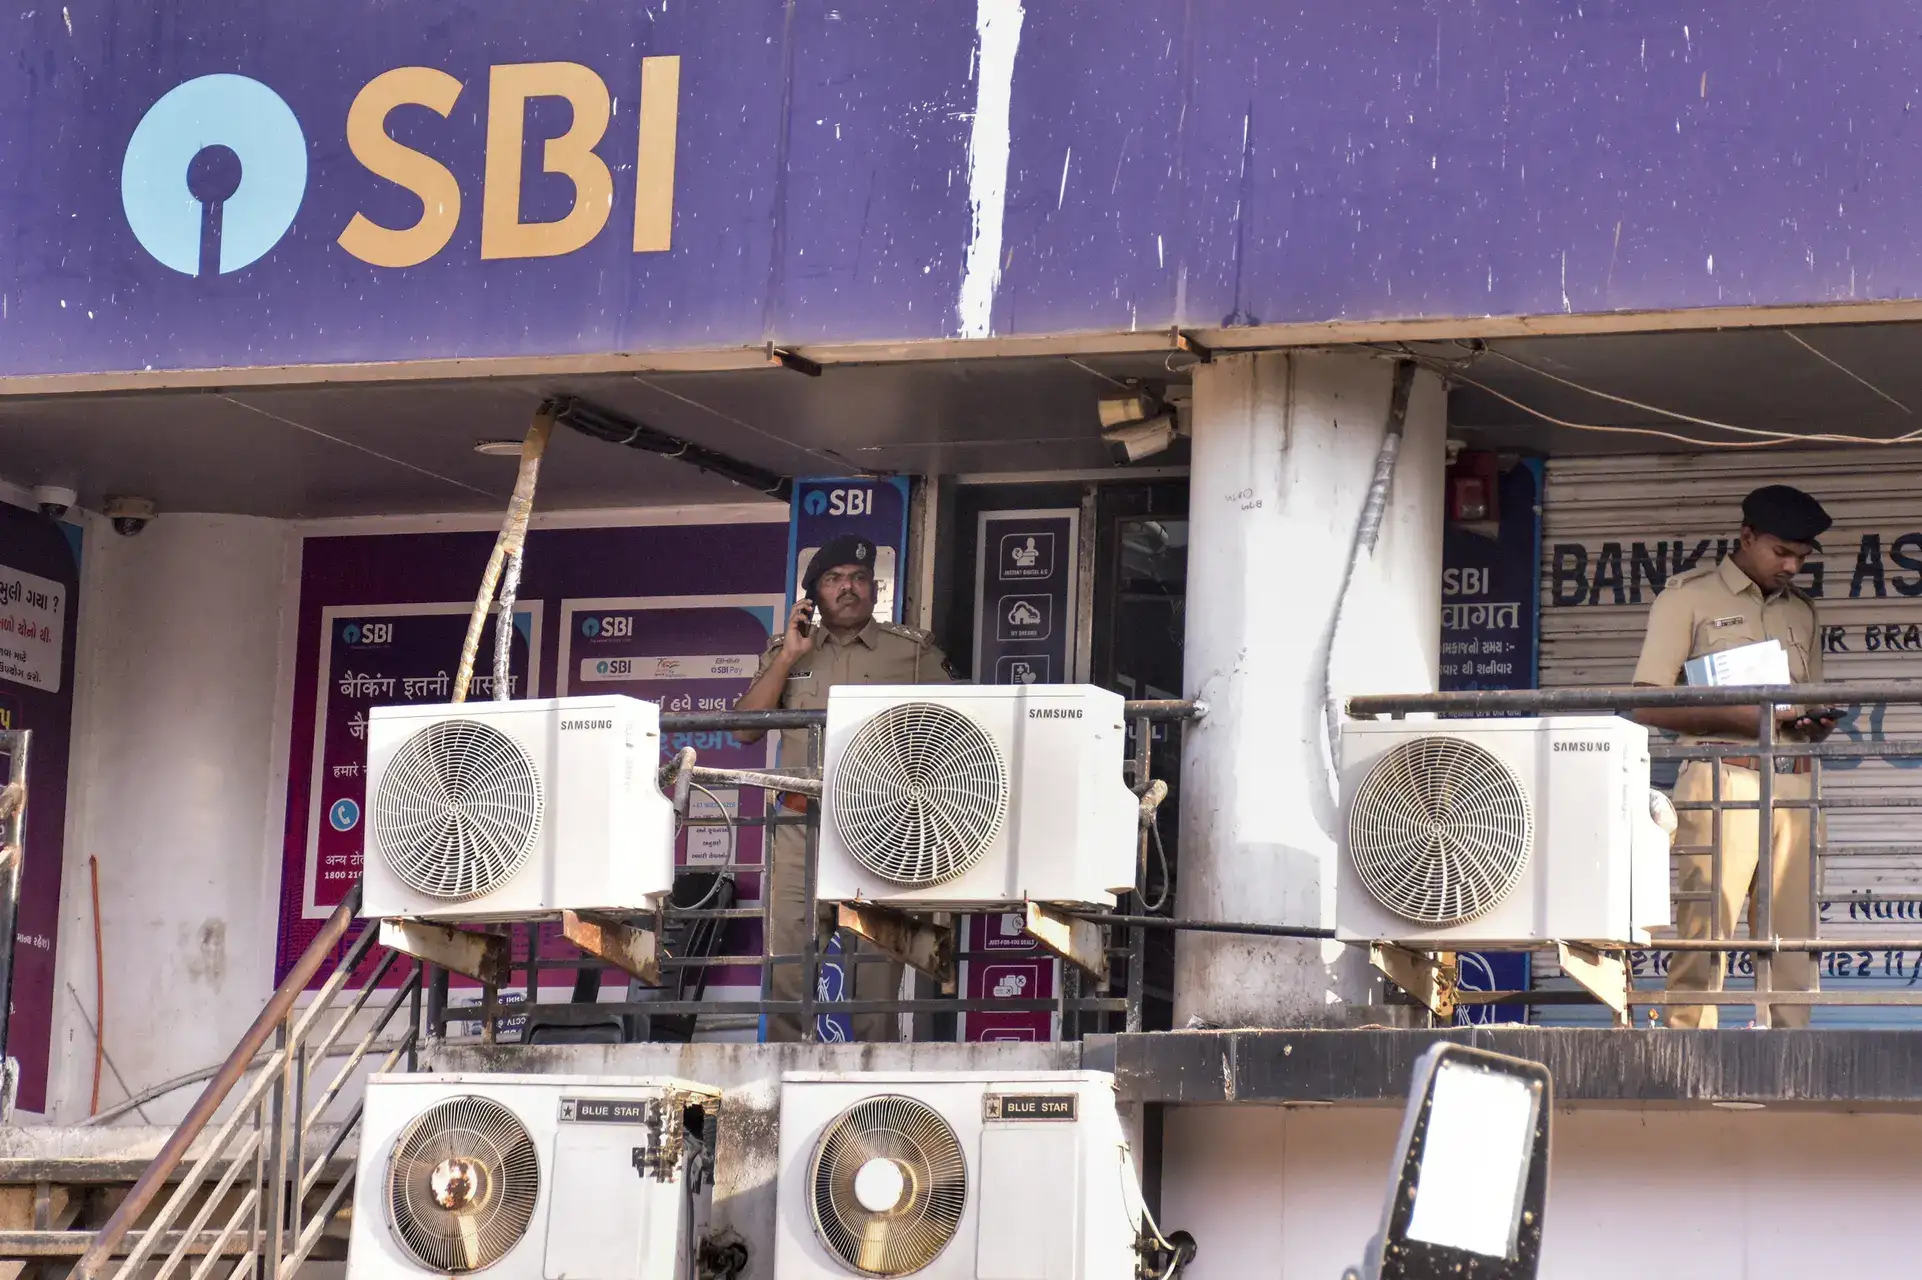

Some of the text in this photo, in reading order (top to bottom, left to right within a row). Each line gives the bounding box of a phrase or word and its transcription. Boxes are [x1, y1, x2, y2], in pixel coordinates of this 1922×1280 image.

[336, 55, 680, 268] SBI
[829, 489, 873, 516] SBI
[1552, 538, 1825, 606] BANK
[1443, 567, 1489, 595] SBI
[1441, 602, 1521, 630] वागत
[361, 623, 393, 644] SBI
[601, 616, 633, 637] SBI
[609, 660, 632, 674] SBI
[717, 666, 743, 675] SBI Pay
[402, 670, 449, 699] इतनी
[1029, 708, 1083, 719] SAMSUNG
[561, 719, 612, 731] SAMSUNG
[1553, 741, 1611, 752] SAMSUNG
[333, 762, 359, 777] हमारे
[325, 855, 347, 866] अन्य
[324, 871, 346, 879] 1800
[582, 1106, 640, 1117] BLUE STAR
[1007, 1102, 1068, 1112] BLUE STAR
